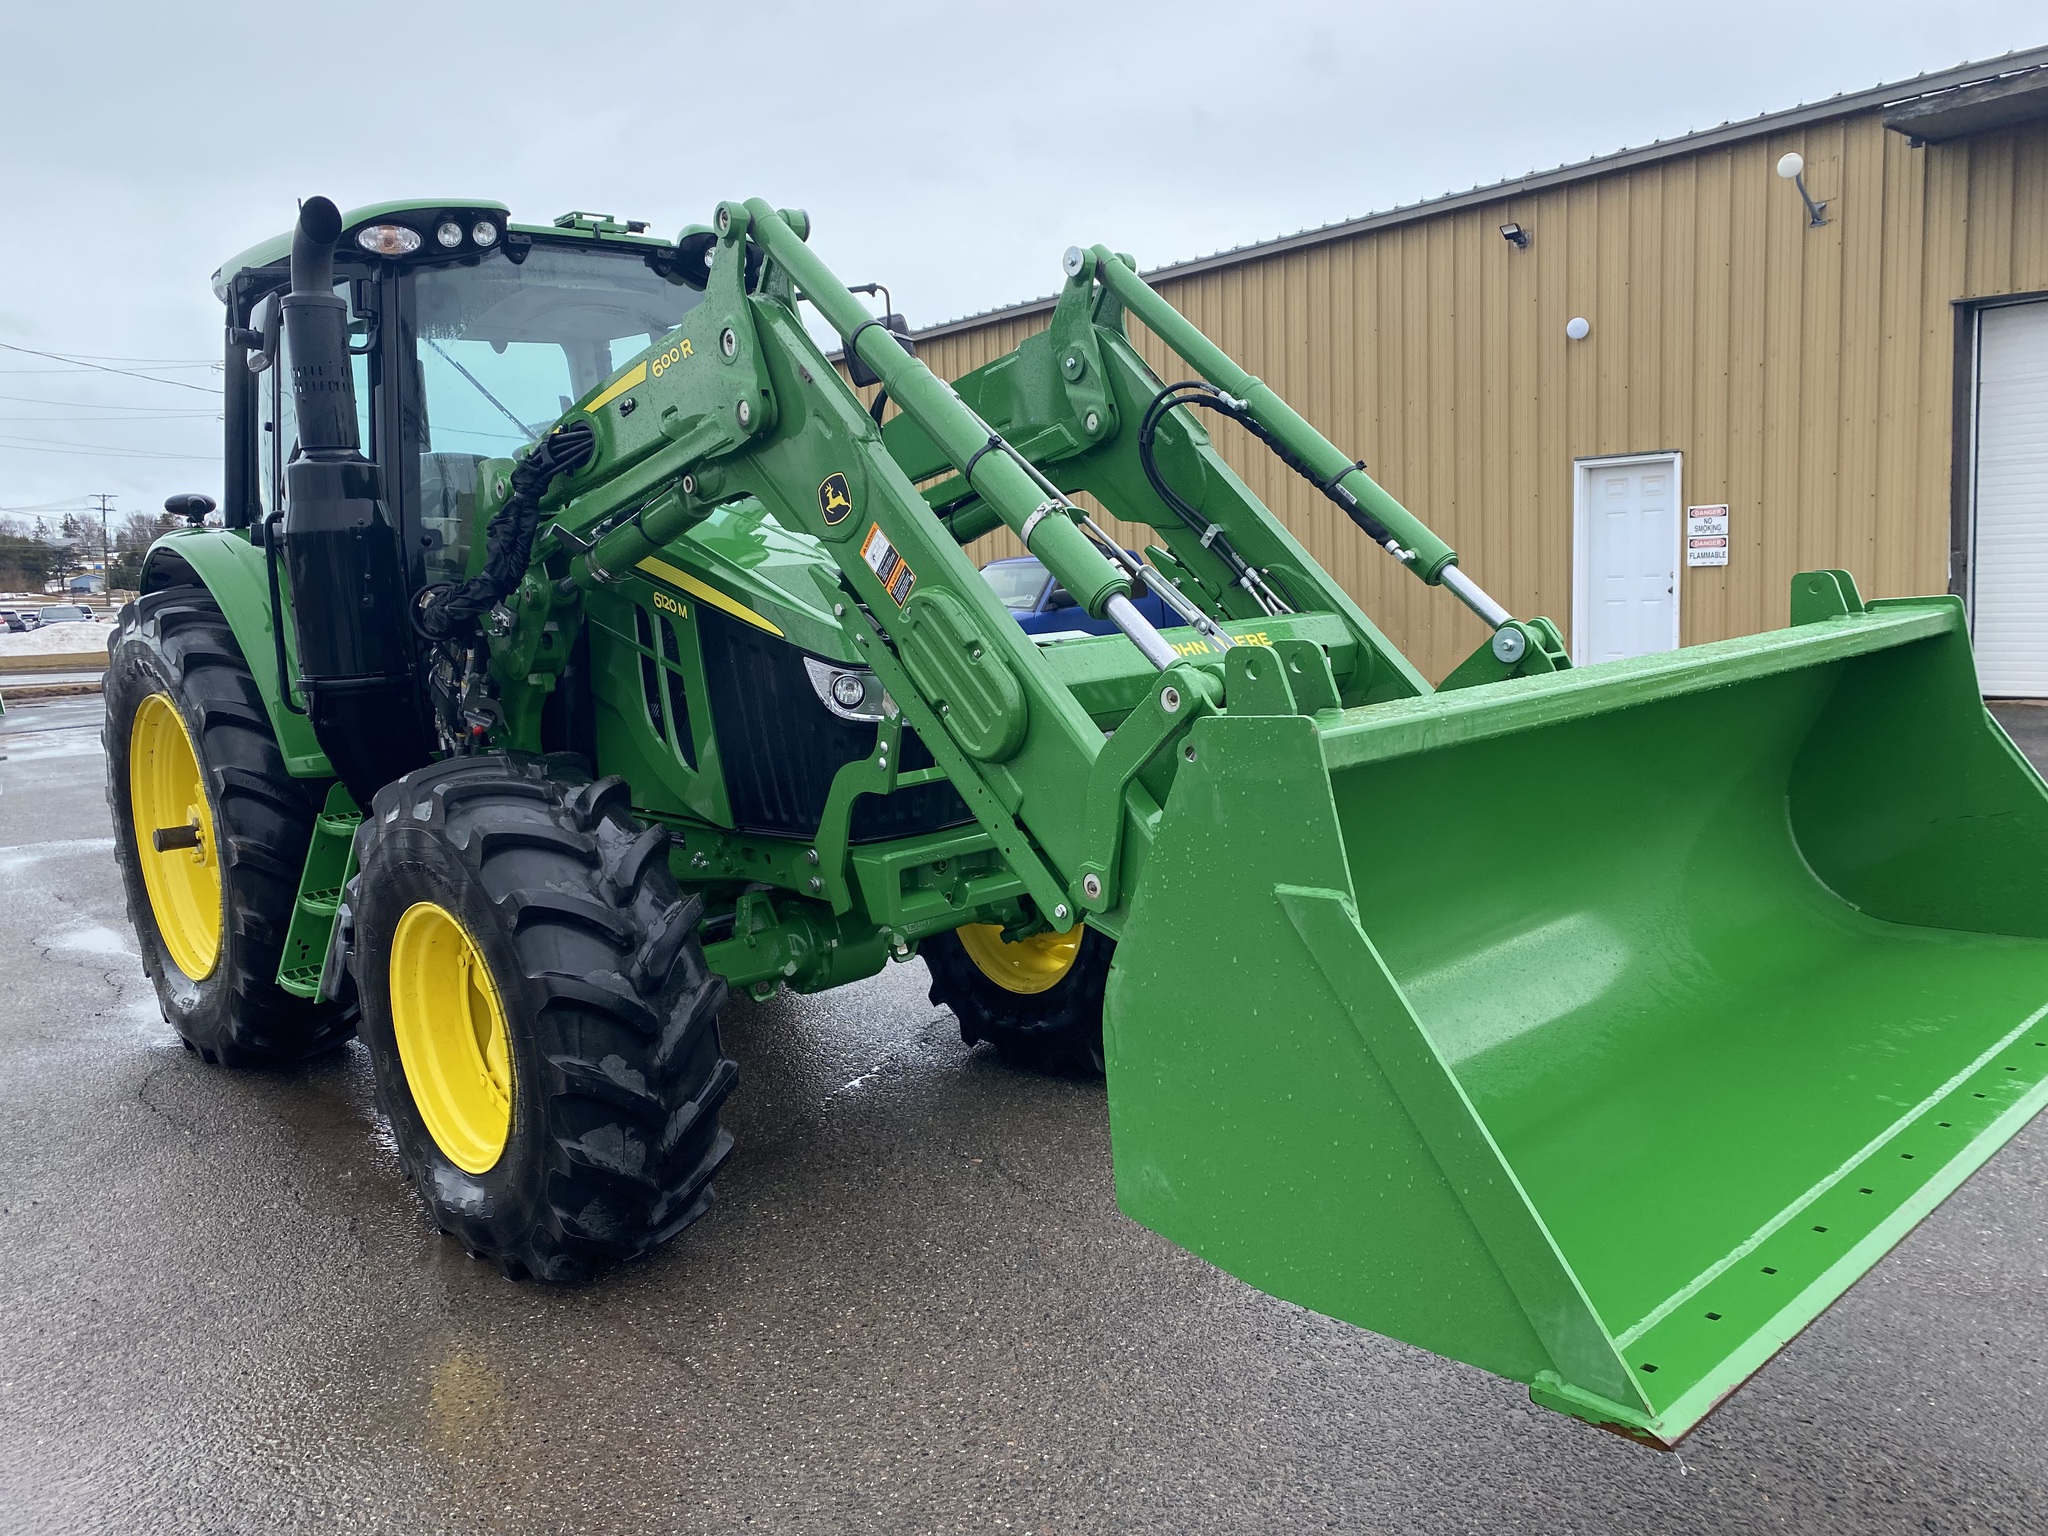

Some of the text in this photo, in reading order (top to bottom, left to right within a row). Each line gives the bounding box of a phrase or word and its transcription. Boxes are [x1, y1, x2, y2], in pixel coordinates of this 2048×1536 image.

[651, 338, 695, 378] 600 R
[1694, 508, 1722, 516] DANGER
[1703, 517, 1713, 525] NO
[1694, 524, 1722, 532] SMOKING
[1694, 539, 1722, 547] DANGER
[1689, 551, 1727, 559] FLAMMABLE
[653, 591, 688, 620] 6120 M
[1170, 632, 1273, 657] OHN DERE
